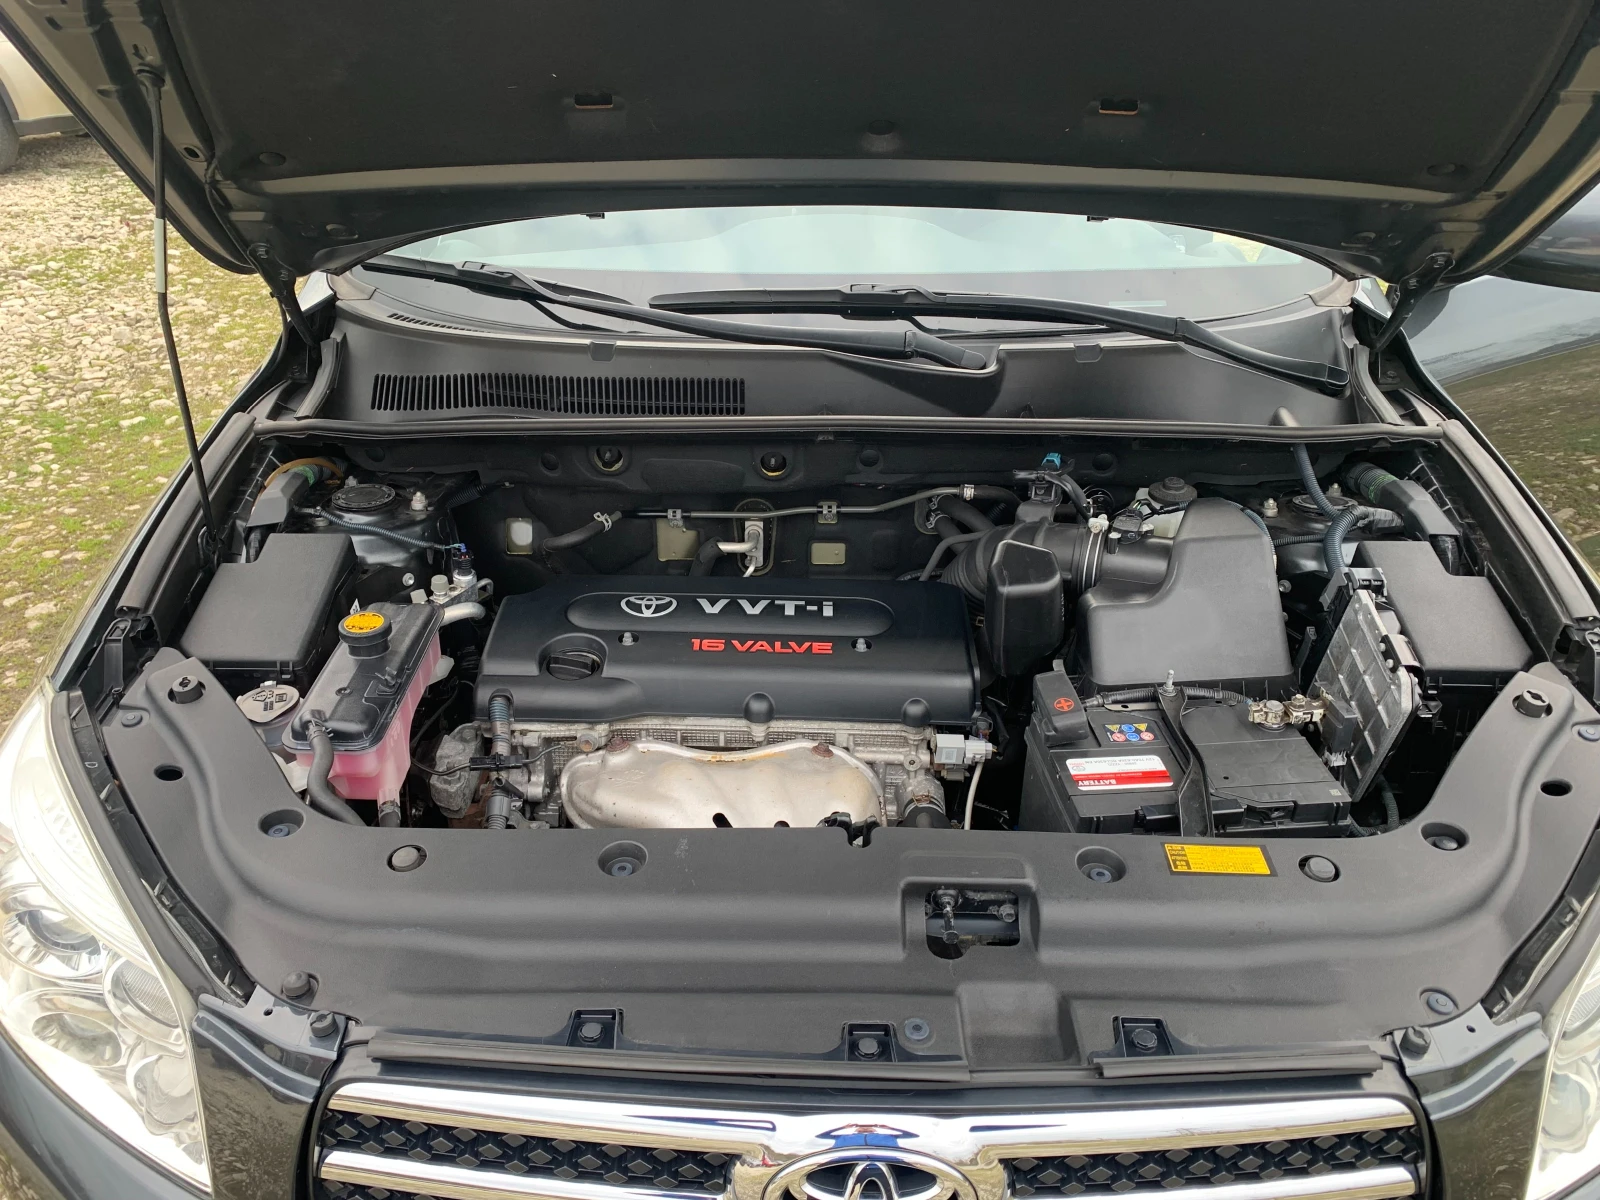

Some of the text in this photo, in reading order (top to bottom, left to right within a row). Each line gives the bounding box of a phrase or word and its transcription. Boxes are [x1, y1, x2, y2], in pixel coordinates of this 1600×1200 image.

[696, 598, 834, 617] VVT-i
[691, 638, 833, 654] 16 VALVE
